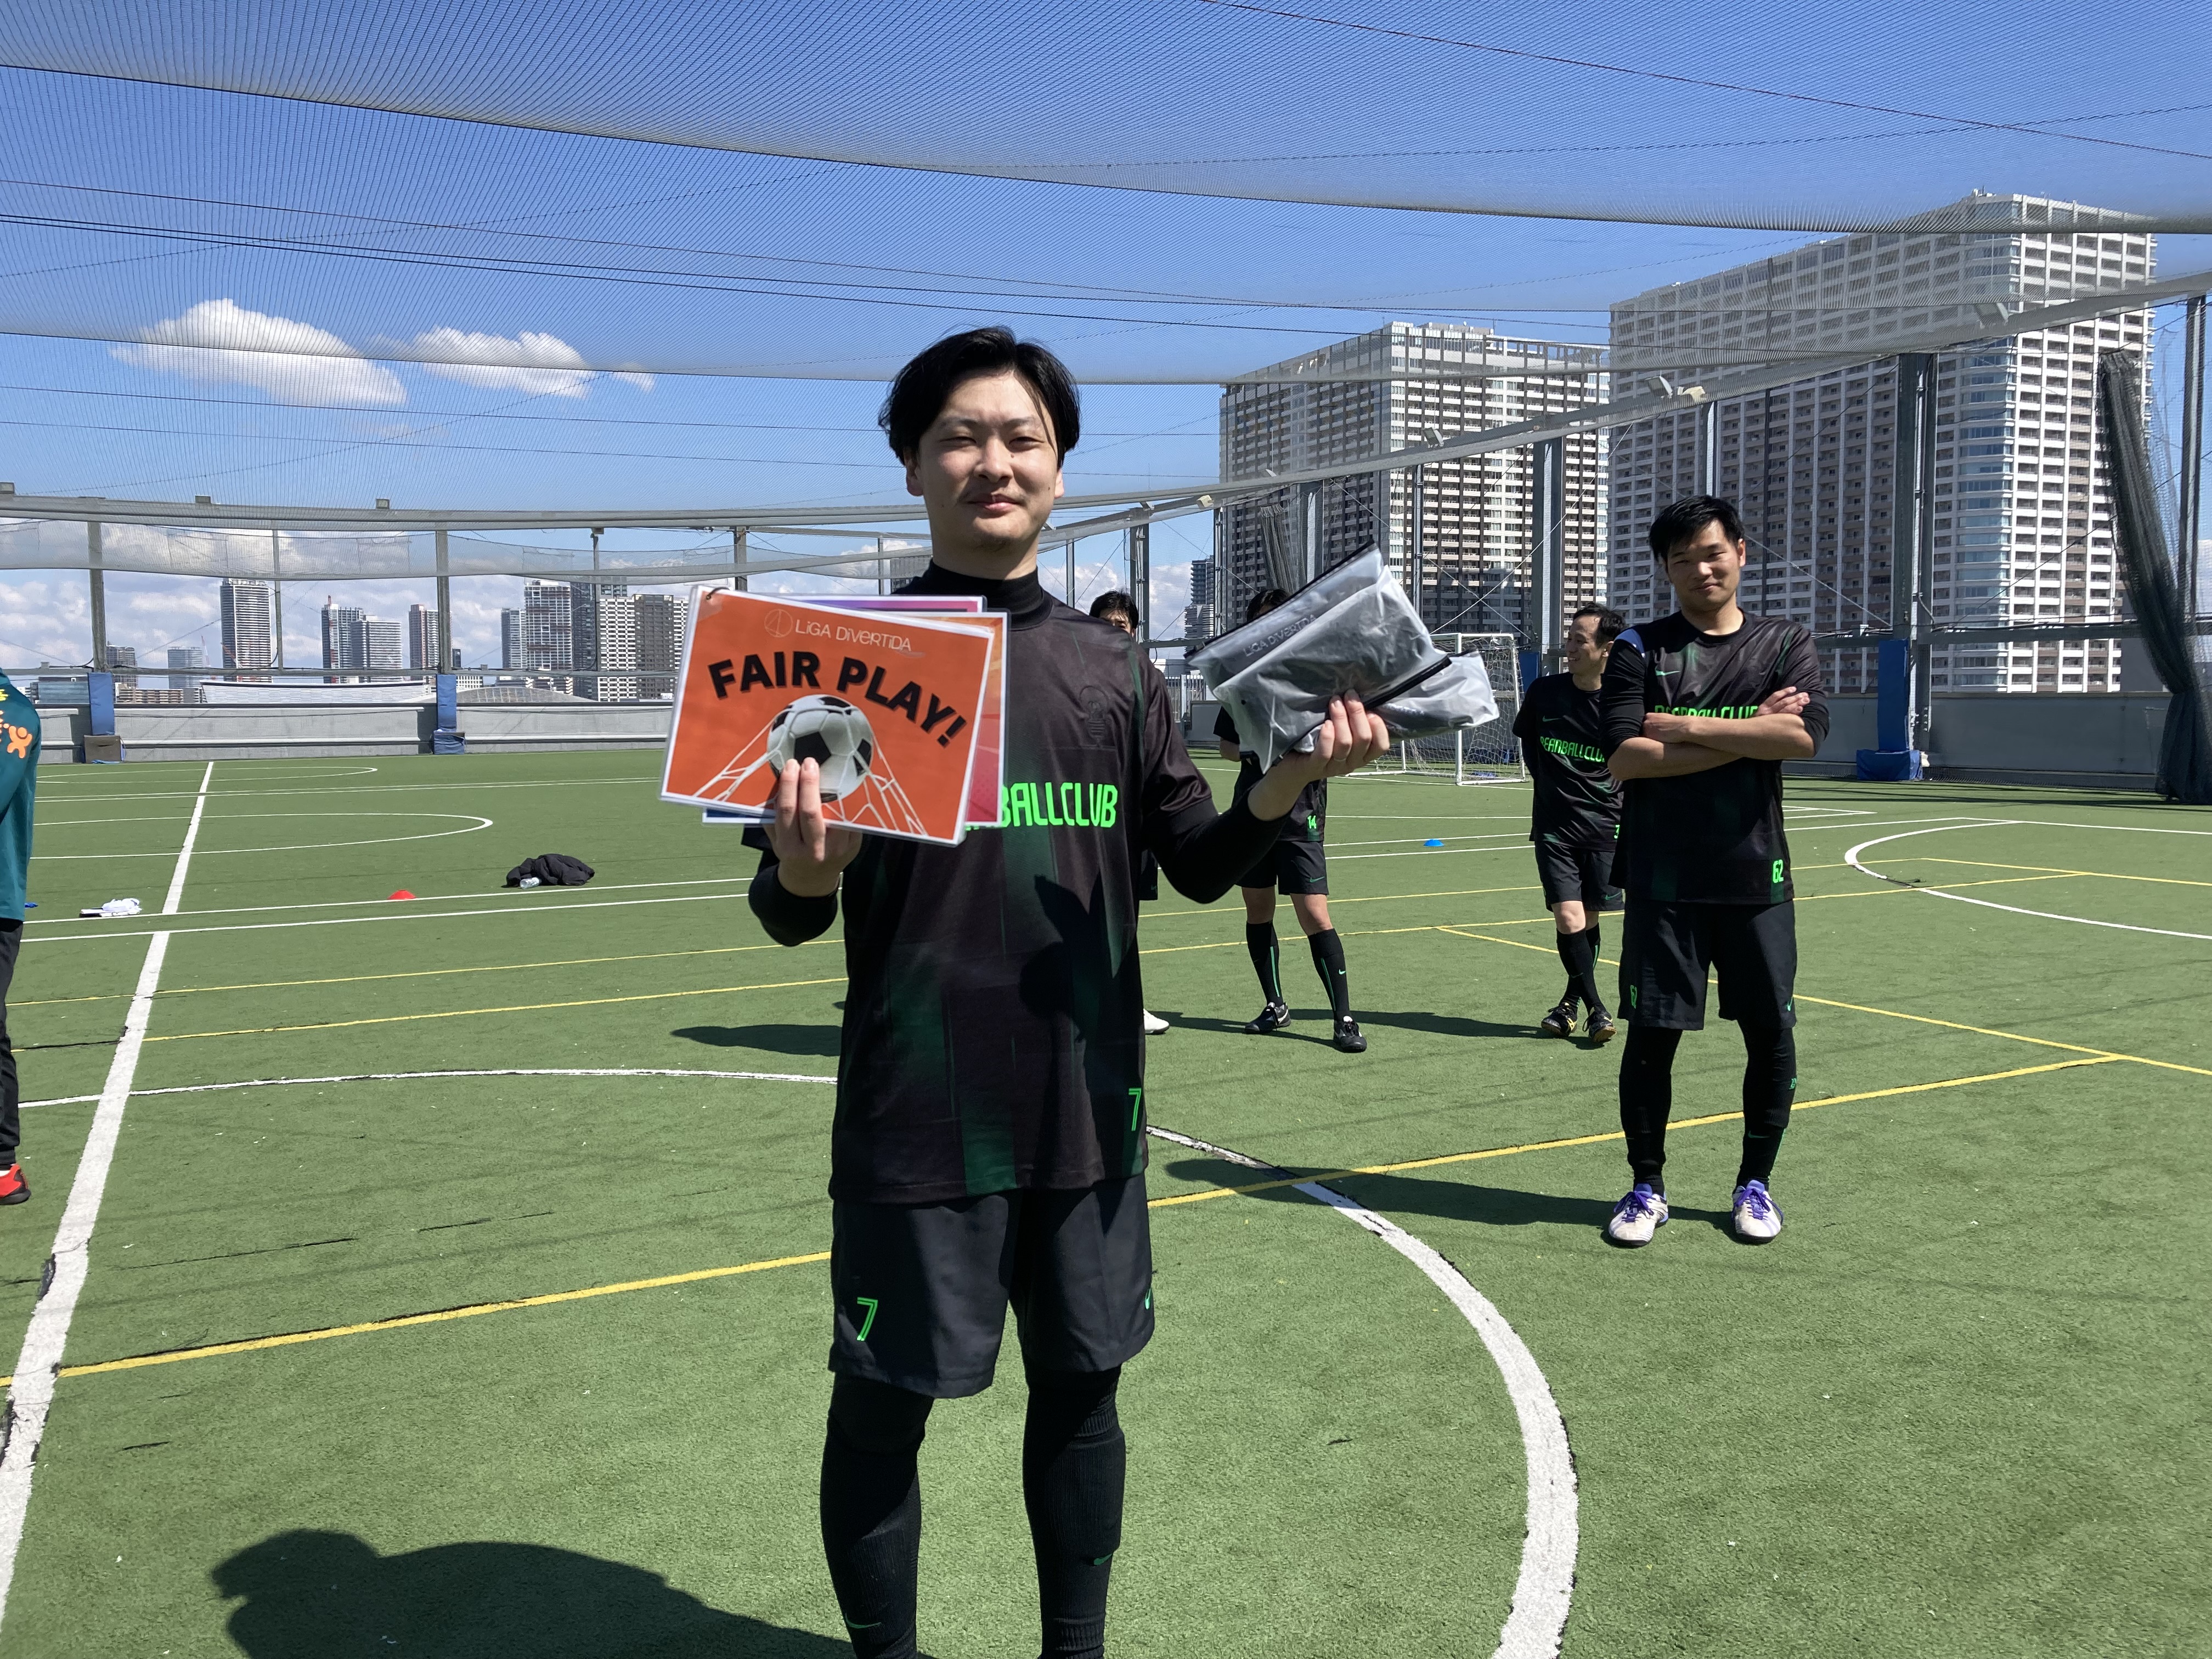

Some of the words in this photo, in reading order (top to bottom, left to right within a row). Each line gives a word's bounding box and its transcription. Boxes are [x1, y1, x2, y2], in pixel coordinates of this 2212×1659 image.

[708, 651, 821, 700] FAIR
[837, 656, 967, 748] PLAY!
[966, 782, 1118, 831] BALLCLUB
[1773, 859, 1784, 883] 62
[1128, 1087, 1142, 1131] 7
[856, 1297, 878, 1341] 7
